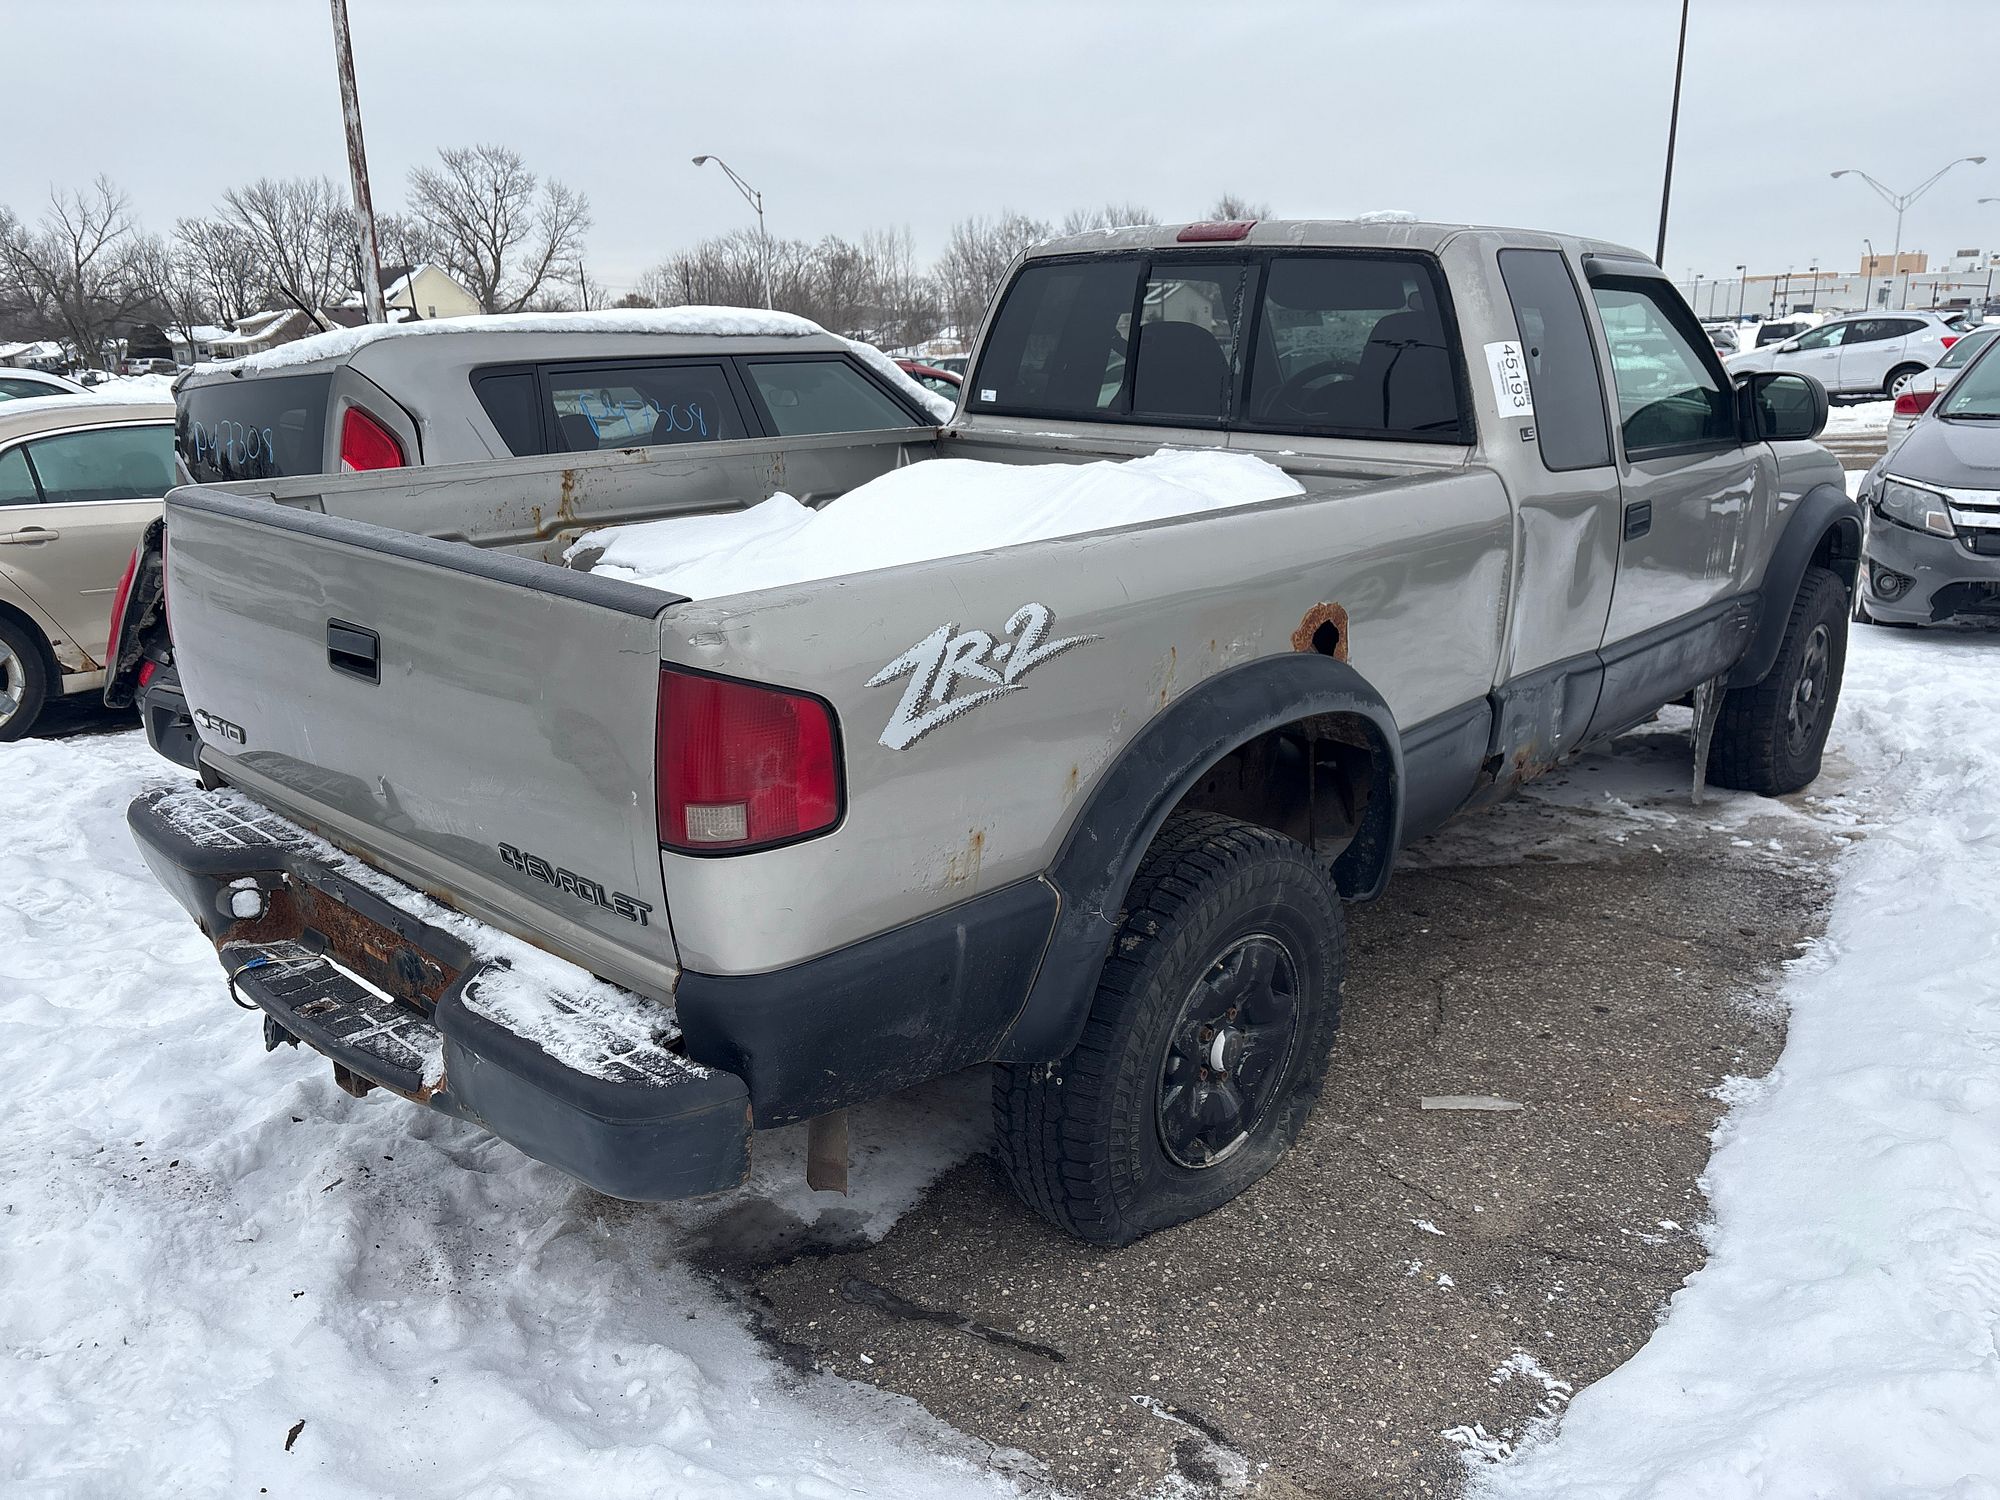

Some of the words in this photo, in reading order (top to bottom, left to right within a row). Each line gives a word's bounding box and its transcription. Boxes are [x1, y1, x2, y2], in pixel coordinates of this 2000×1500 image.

[1503, 344, 1526, 408] 45193
[194, 419, 273, 465] P47308
[498, 841, 653, 926] CHEVROLET
